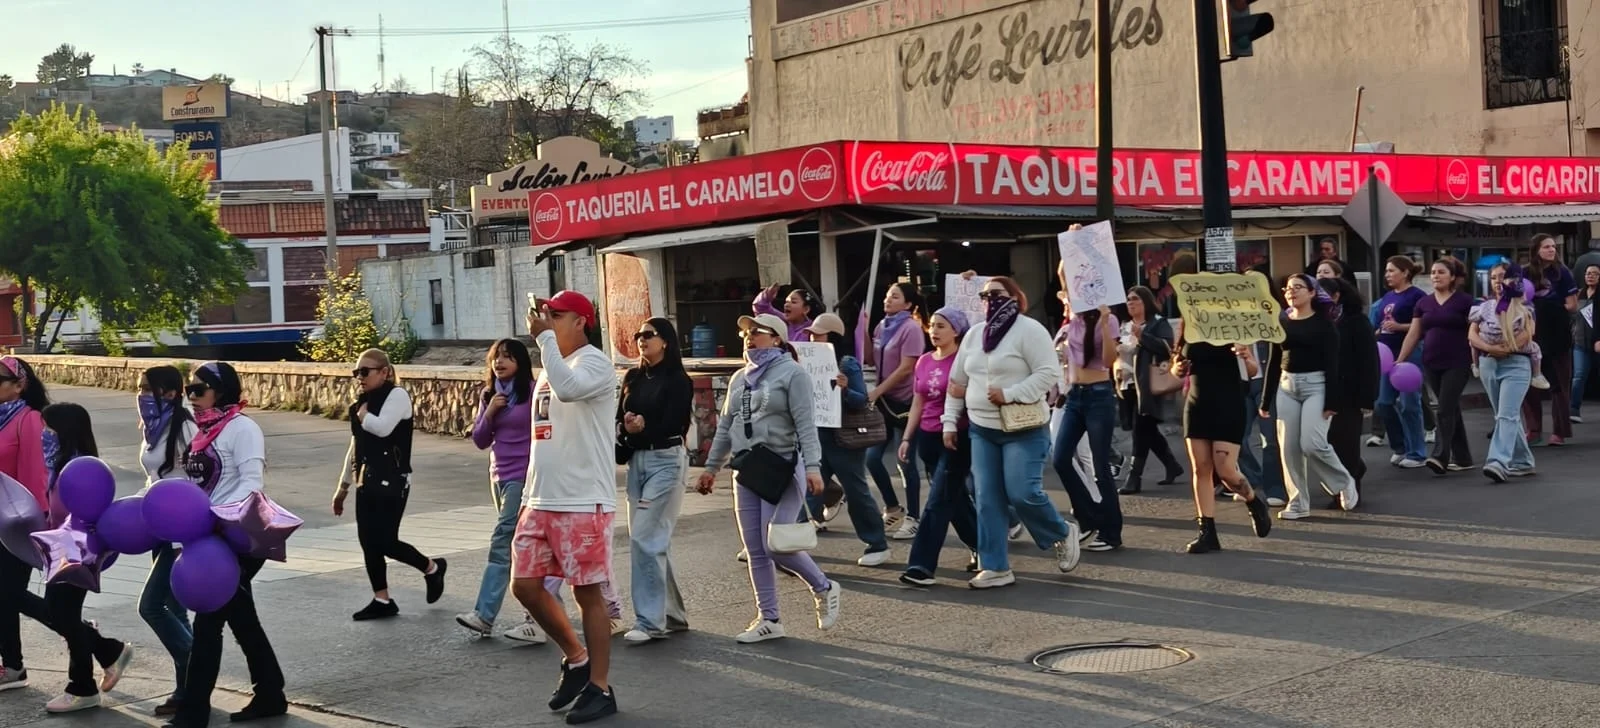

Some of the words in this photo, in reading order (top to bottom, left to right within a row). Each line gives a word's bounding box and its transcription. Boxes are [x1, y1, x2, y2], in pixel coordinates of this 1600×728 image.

[898, 22, 983, 109] Café
[171, 106, 215, 116] Construrama
[498, 162, 568, 192] Salón
[801, 165, 832, 183] Coca-Cola
[861, 151, 948, 192] Coca-Cola
[1477, 165, 1505, 194] EL
[565, 188, 655, 224] TAQUERIA
[658, 185, 681, 211] EL
[685, 169, 795, 207] CARAMELO
[1186, 296, 1200, 306] de
[1189, 310, 1209, 323] NO
[1258, 323, 1282, 340] 8M
